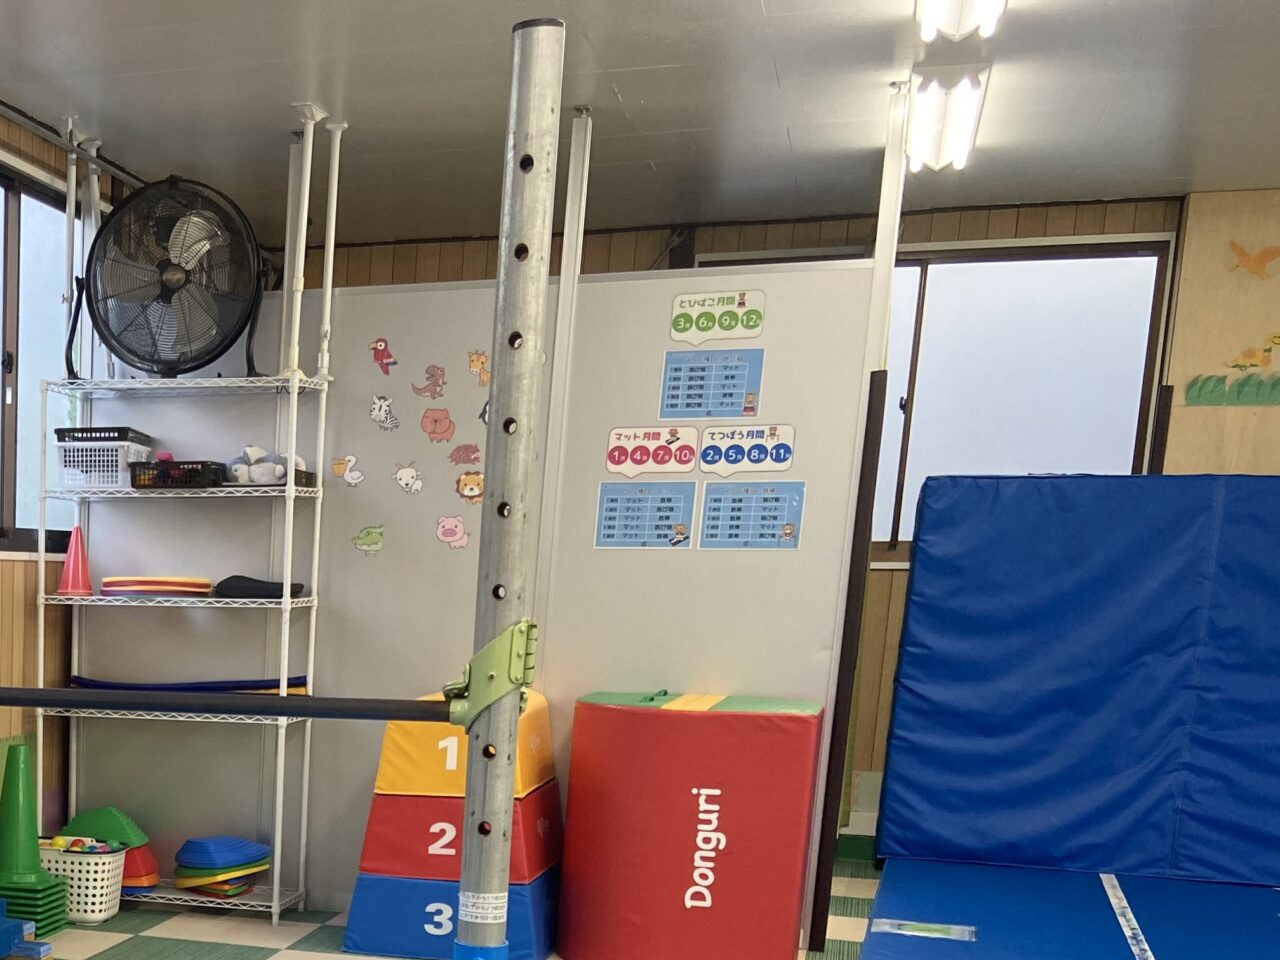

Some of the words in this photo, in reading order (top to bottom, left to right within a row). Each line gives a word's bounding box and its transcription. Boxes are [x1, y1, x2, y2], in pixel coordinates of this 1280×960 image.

[614, 431, 661, 441] マット月間
[708, 430, 765, 441] てつぼう月間
[437, 736, 458, 771] 1
[427, 822, 457, 856] 2
[685, 788, 726, 909] Donguri
[423, 902, 454, 936] 3
